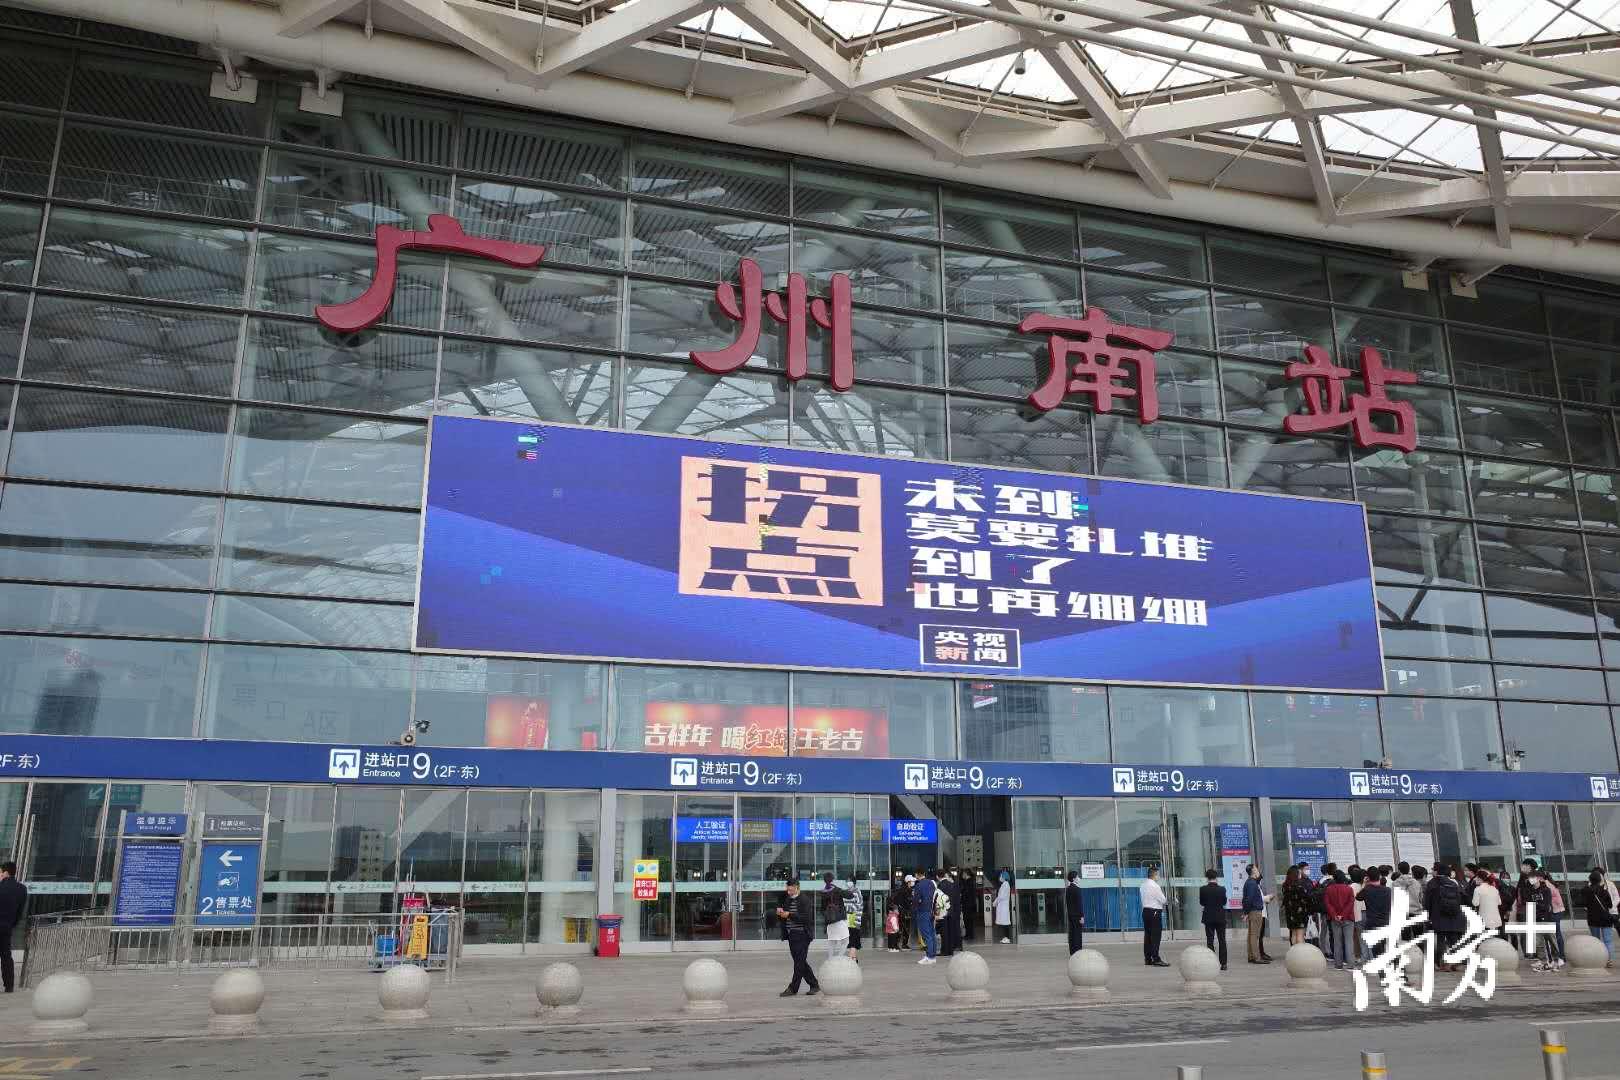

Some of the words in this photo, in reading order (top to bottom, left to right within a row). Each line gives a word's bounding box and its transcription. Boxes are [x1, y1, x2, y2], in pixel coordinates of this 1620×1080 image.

[314, 213, 1419, 453] 广州南站
[904, 478, 1076, 520] 未到
[695, 463, 863, 600] 拐点
[905, 512, 1213, 562] 莫要扎堆
[909, 546, 1076, 585] 到了
[905, 581, 1209, 626] 也再绷绷
[934, 630, 1007, 648] 央视
[935, 646, 1008, 663] 新闻
[644, 722, 713, 747] 吉祥年
[362, 768, 401, 778] Entrance
[364, 752, 410, 768] 进站口
[412, 752, 431, 779] 9
[701, 761, 741, 775] 进站口
[743, 761, 759, 786] 9
[700, 776, 734, 785] Entrance
[931, 766, 967, 780] 进站口
[969, 766, 984, 790] 9
[931, 781, 962, 789] Entrance
[1137, 769, 1169, 783] 进站口
[1170, 770, 1184, 792] 9
[1137, 783, 1164, 792] Entrance
[1371, 774, 1399, 787] 进站口
[1400, 774, 1412, 795] 9
[695, 820, 727, 829] 人工验证
[896, 822, 924, 831] 自助验证
[215, 896, 252, 909] 售票处
